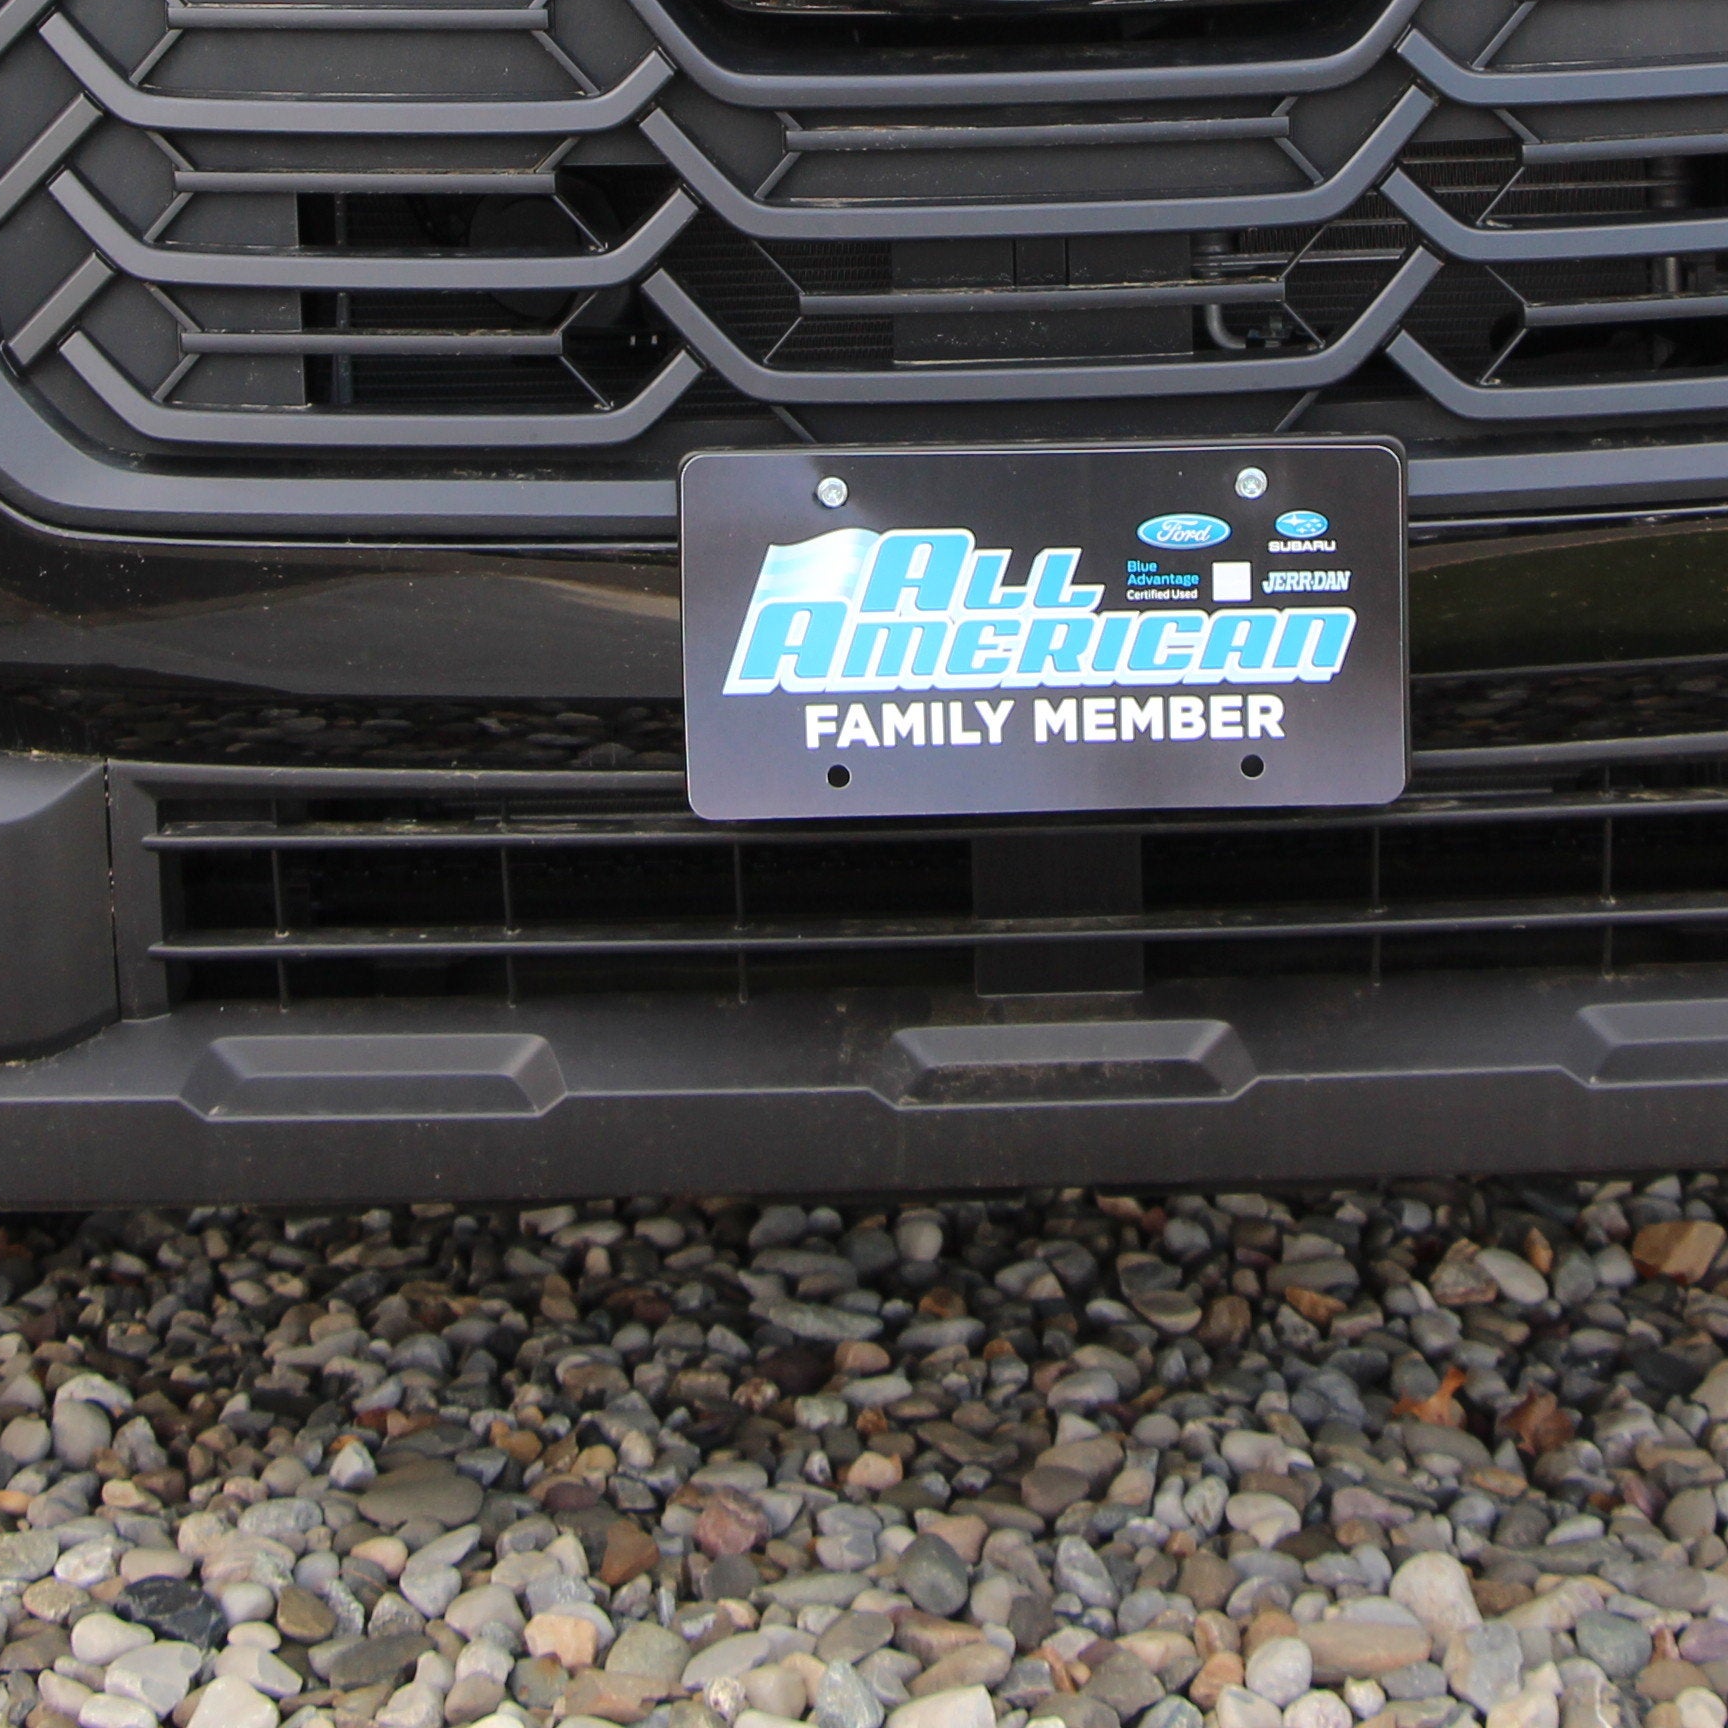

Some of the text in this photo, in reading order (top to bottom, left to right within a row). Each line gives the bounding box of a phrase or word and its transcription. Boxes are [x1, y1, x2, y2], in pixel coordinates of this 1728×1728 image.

[1156, 519, 1211, 543] Ford
[1268, 540, 1336, 553] SUBARU
[857, 529, 1104, 613] ALL
[1127, 560, 1158, 572] Blue
[1126, 573, 1200, 588] Advantage
[1126, 588, 1198, 601] Certified Used
[729, 599, 1355, 690] AMERICAN
[804, 693, 1286, 749] FAMILY MEMBER
